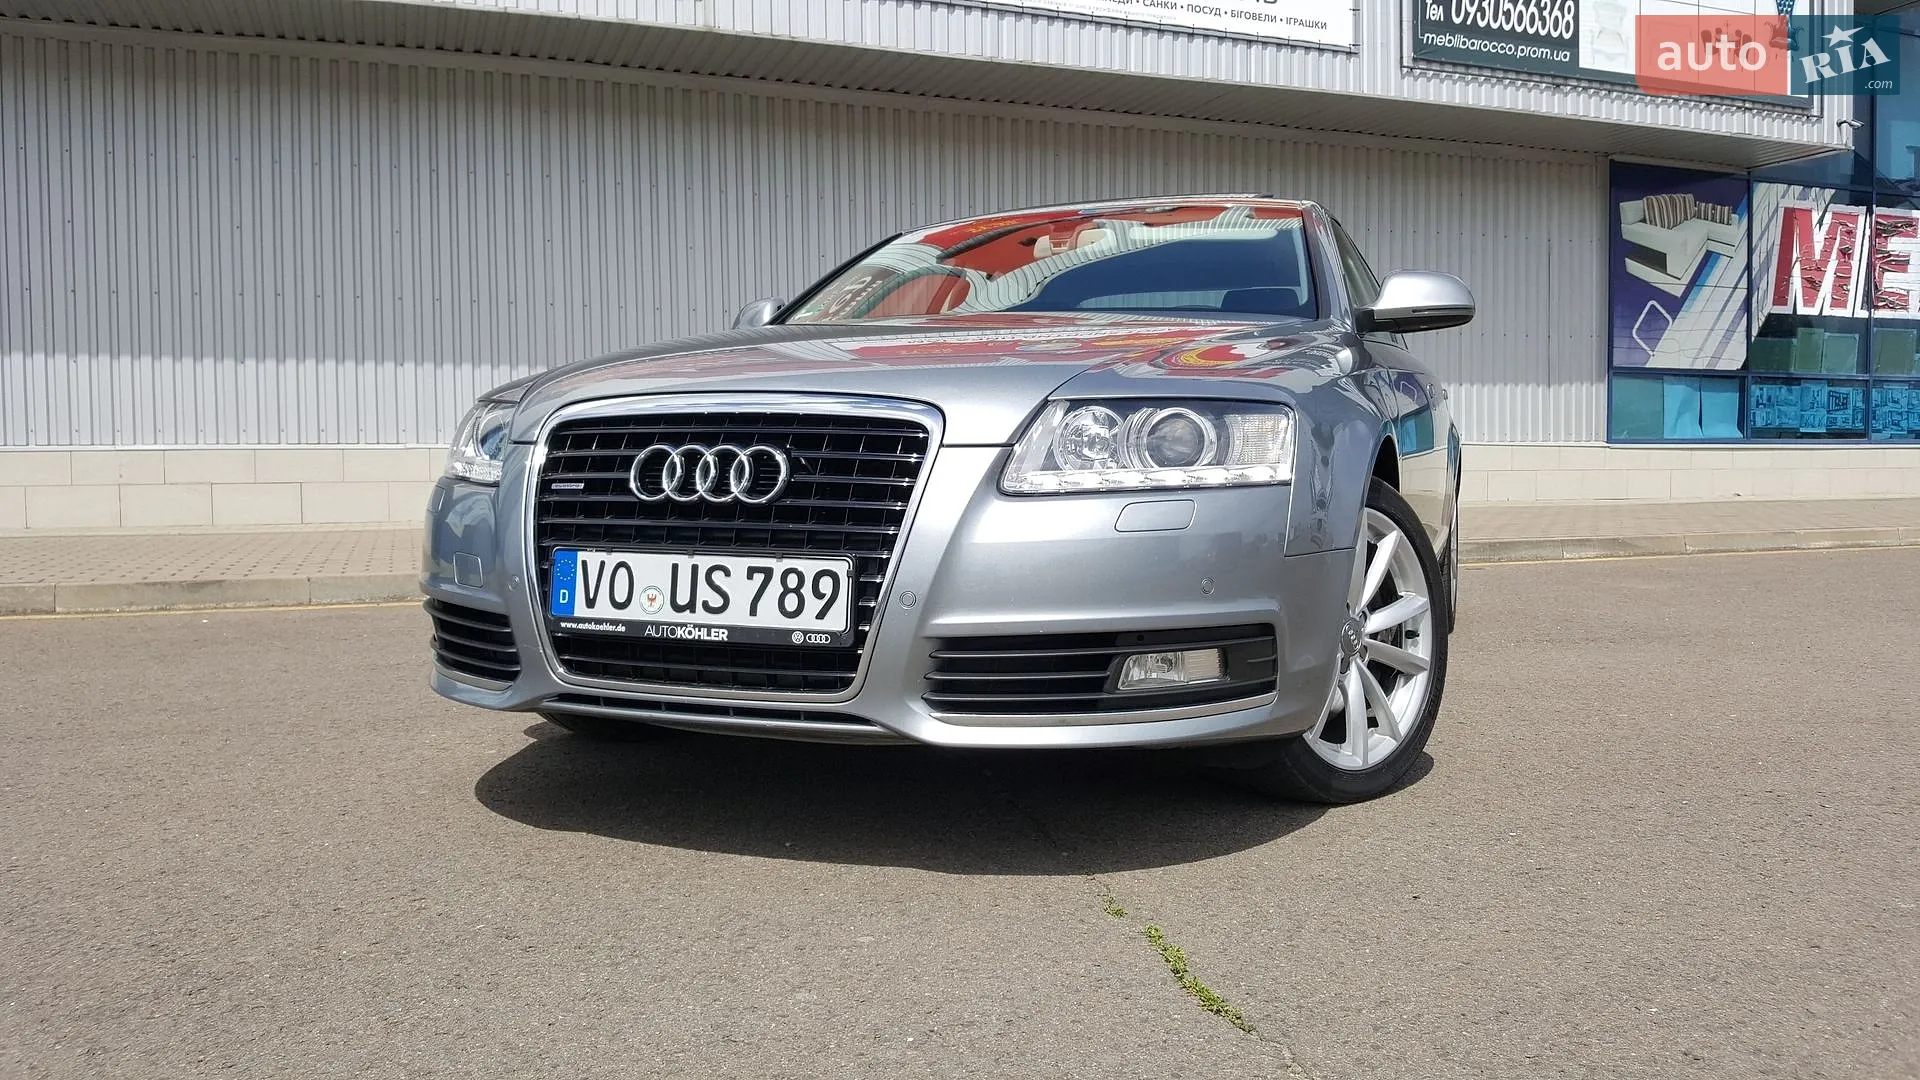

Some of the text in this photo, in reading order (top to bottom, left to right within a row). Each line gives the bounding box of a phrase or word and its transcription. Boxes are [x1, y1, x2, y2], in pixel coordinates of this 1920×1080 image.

[1142, 0, 1178, 11] САНКИ
[1186, 3, 1222, 17] ПОСУД
[1230, 9, 1277, 23] БІГОВЕЛИ
[1285, 17, 1328, 30] ІГРАШКИ
[1425, 0, 1575, 39] Тел 0930566368
[1423, 32, 1571, 62] meblibarocco.prom.ua
[558, 589, 569, 604] D
[580, 559, 842, 620] VO US 789
[560, 620, 626, 632] www.autokoehler.de
[644, 623, 729, 642] AUTOKÖHLER
